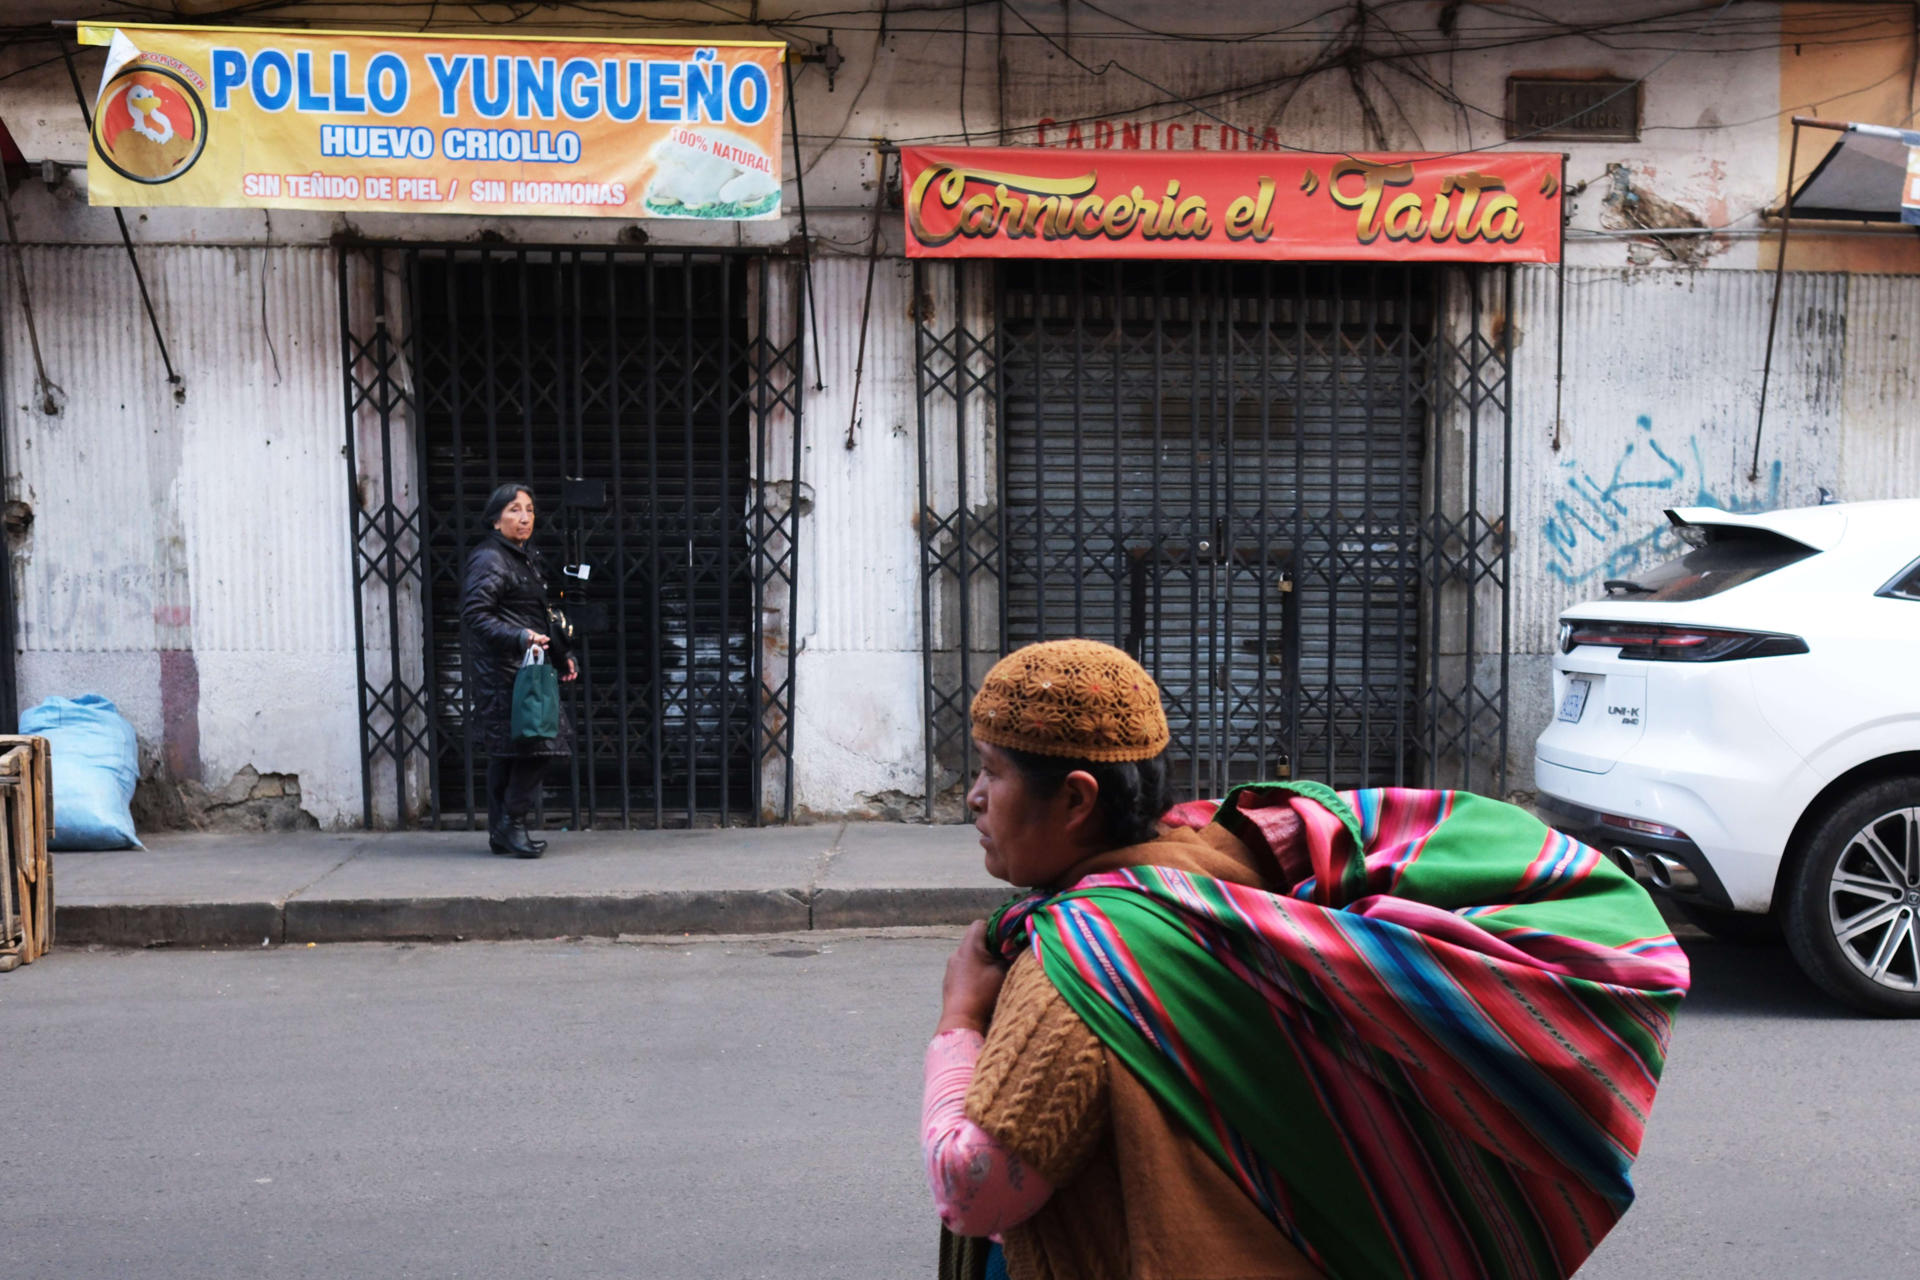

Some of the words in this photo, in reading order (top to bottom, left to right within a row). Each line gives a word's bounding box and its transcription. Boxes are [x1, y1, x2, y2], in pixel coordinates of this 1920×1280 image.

[209, 47, 411, 116] POLLO
[426, 47, 772, 125] YUNGUEÑO
[321, 125, 434, 159] HUEVO
[442, 128, 581, 163] CRIOLLO
[671, 127, 708, 153] 100%
[712, 140, 772, 174] NATURAL
[244, 174, 280, 198] SIN
[285, 172, 359, 200] TEÑIDO
[365, 177, 392, 200] DE
[398, 178, 443, 201] PIEL
[470, 179, 506, 202] SIN
[512, 181, 626, 205] HORMONAS
[908, 161, 1213, 248] Carniceria
[1225, 176, 1275, 242] el
